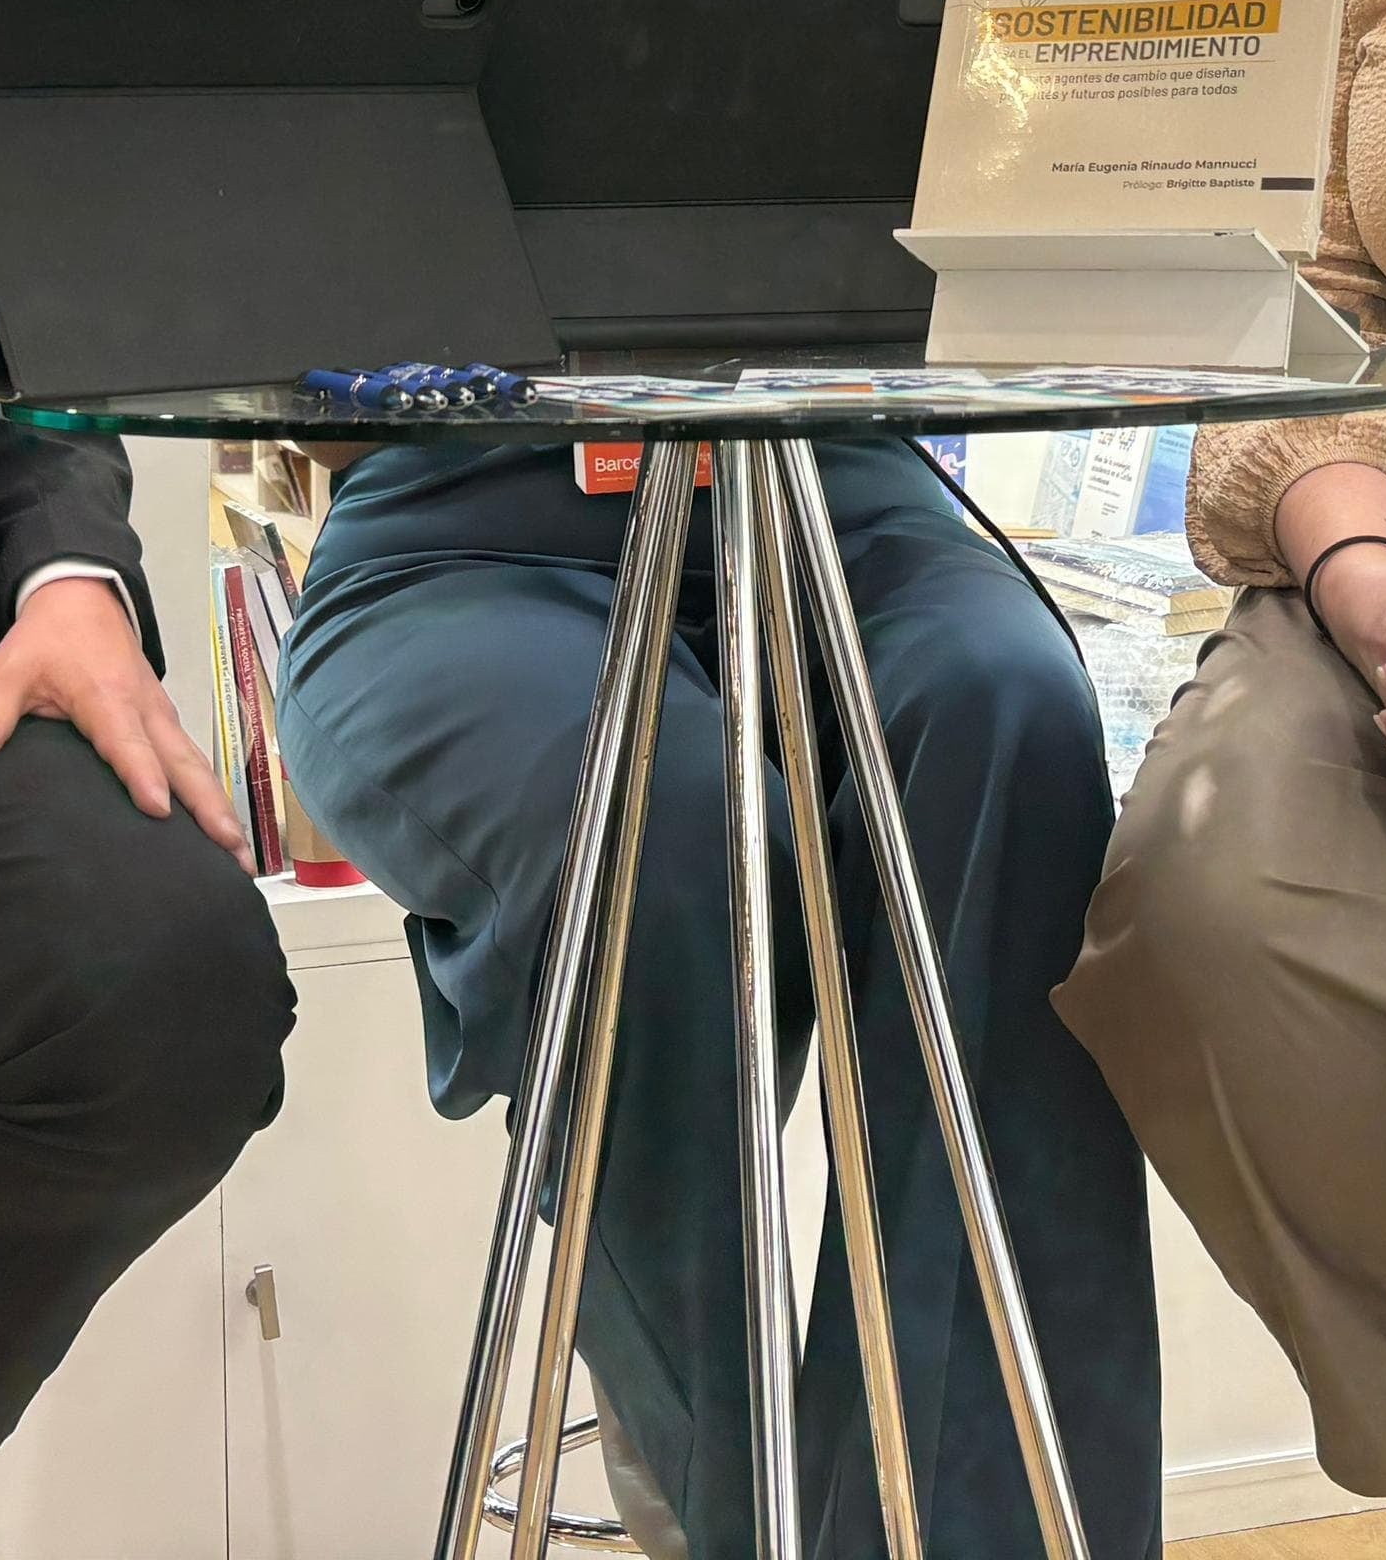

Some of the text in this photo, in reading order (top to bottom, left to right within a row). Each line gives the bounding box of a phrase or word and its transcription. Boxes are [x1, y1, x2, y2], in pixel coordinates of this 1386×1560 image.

[995, 1, 1267, 38] SOSTENIBILIDAD
[1035, 36, 1261, 63] EMPRENDIMIENTO
[1054, 67, 1245, 86] agentes de cambio que diseñan
[1061, 84, 1238, 102] y futuros posibles para todos
[1052, 158, 1257, 174] María Eugenia Rinaudo Mannucci
[1166, 179, 1255, 189] Brigitte Baptiste
